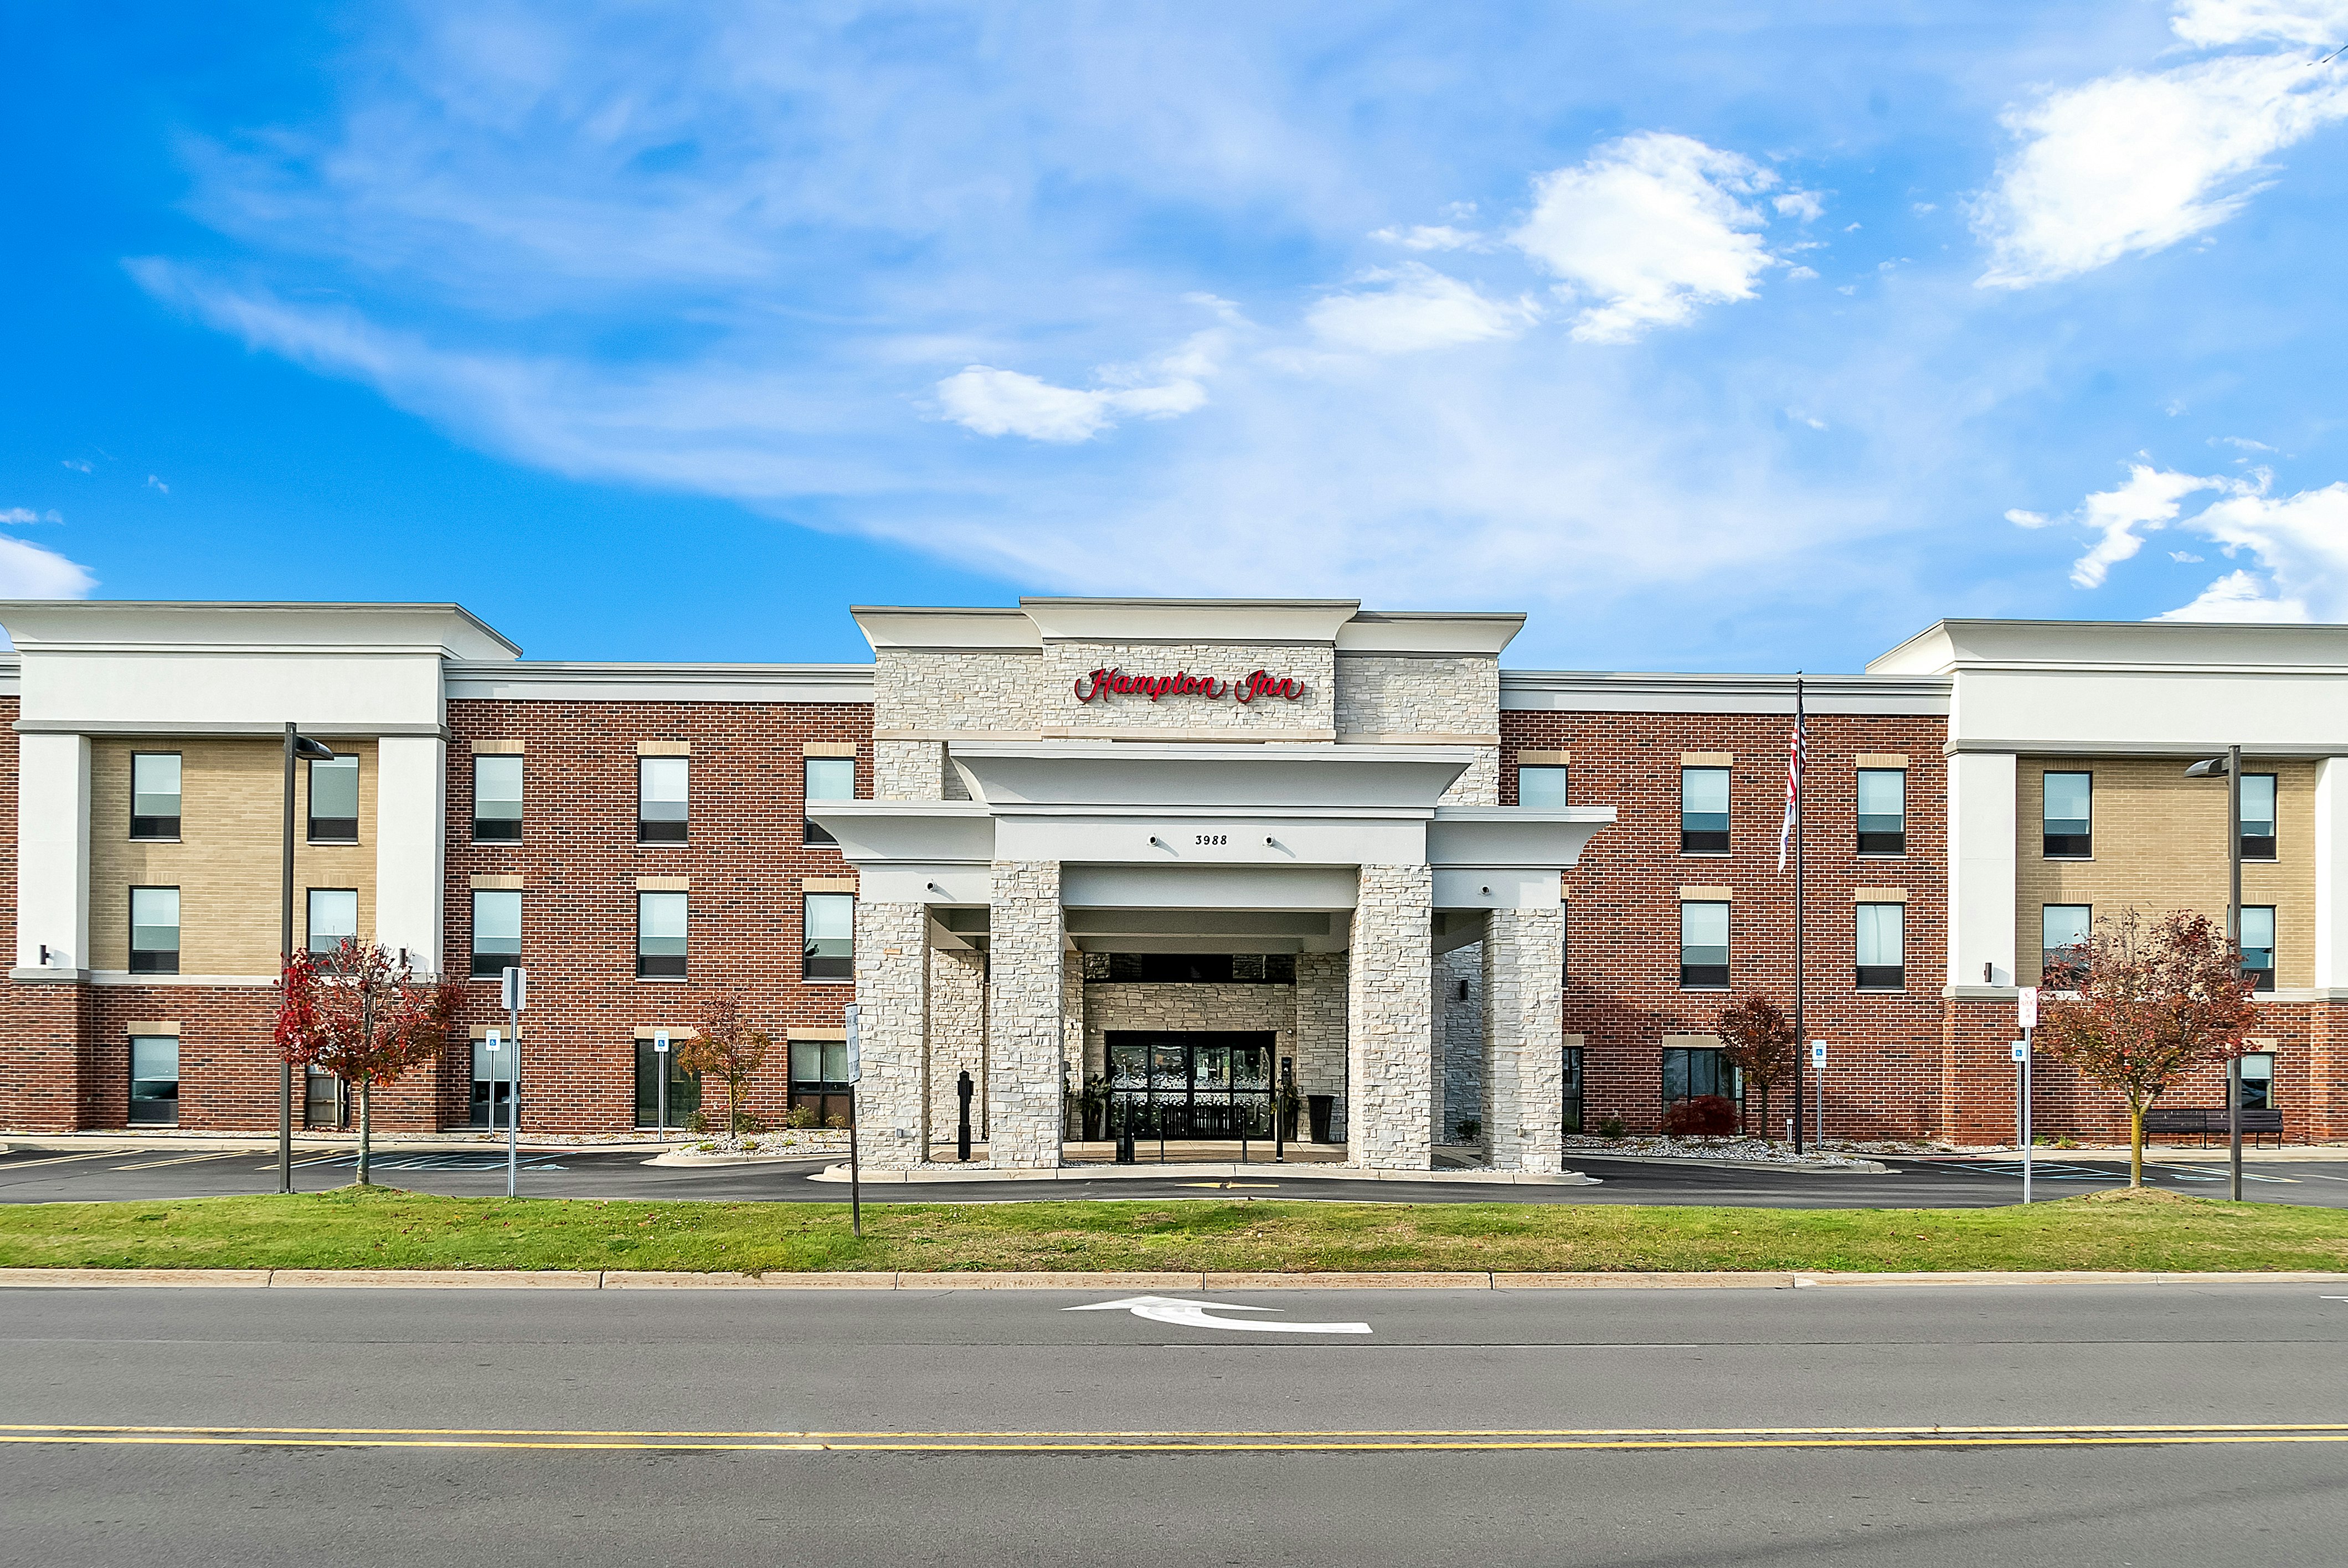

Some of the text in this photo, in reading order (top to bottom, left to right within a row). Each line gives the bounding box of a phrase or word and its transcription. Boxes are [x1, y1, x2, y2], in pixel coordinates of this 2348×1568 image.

[1074, 667, 1305, 703] Hampton Inn
[1195, 834, 1227, 845] 3988
